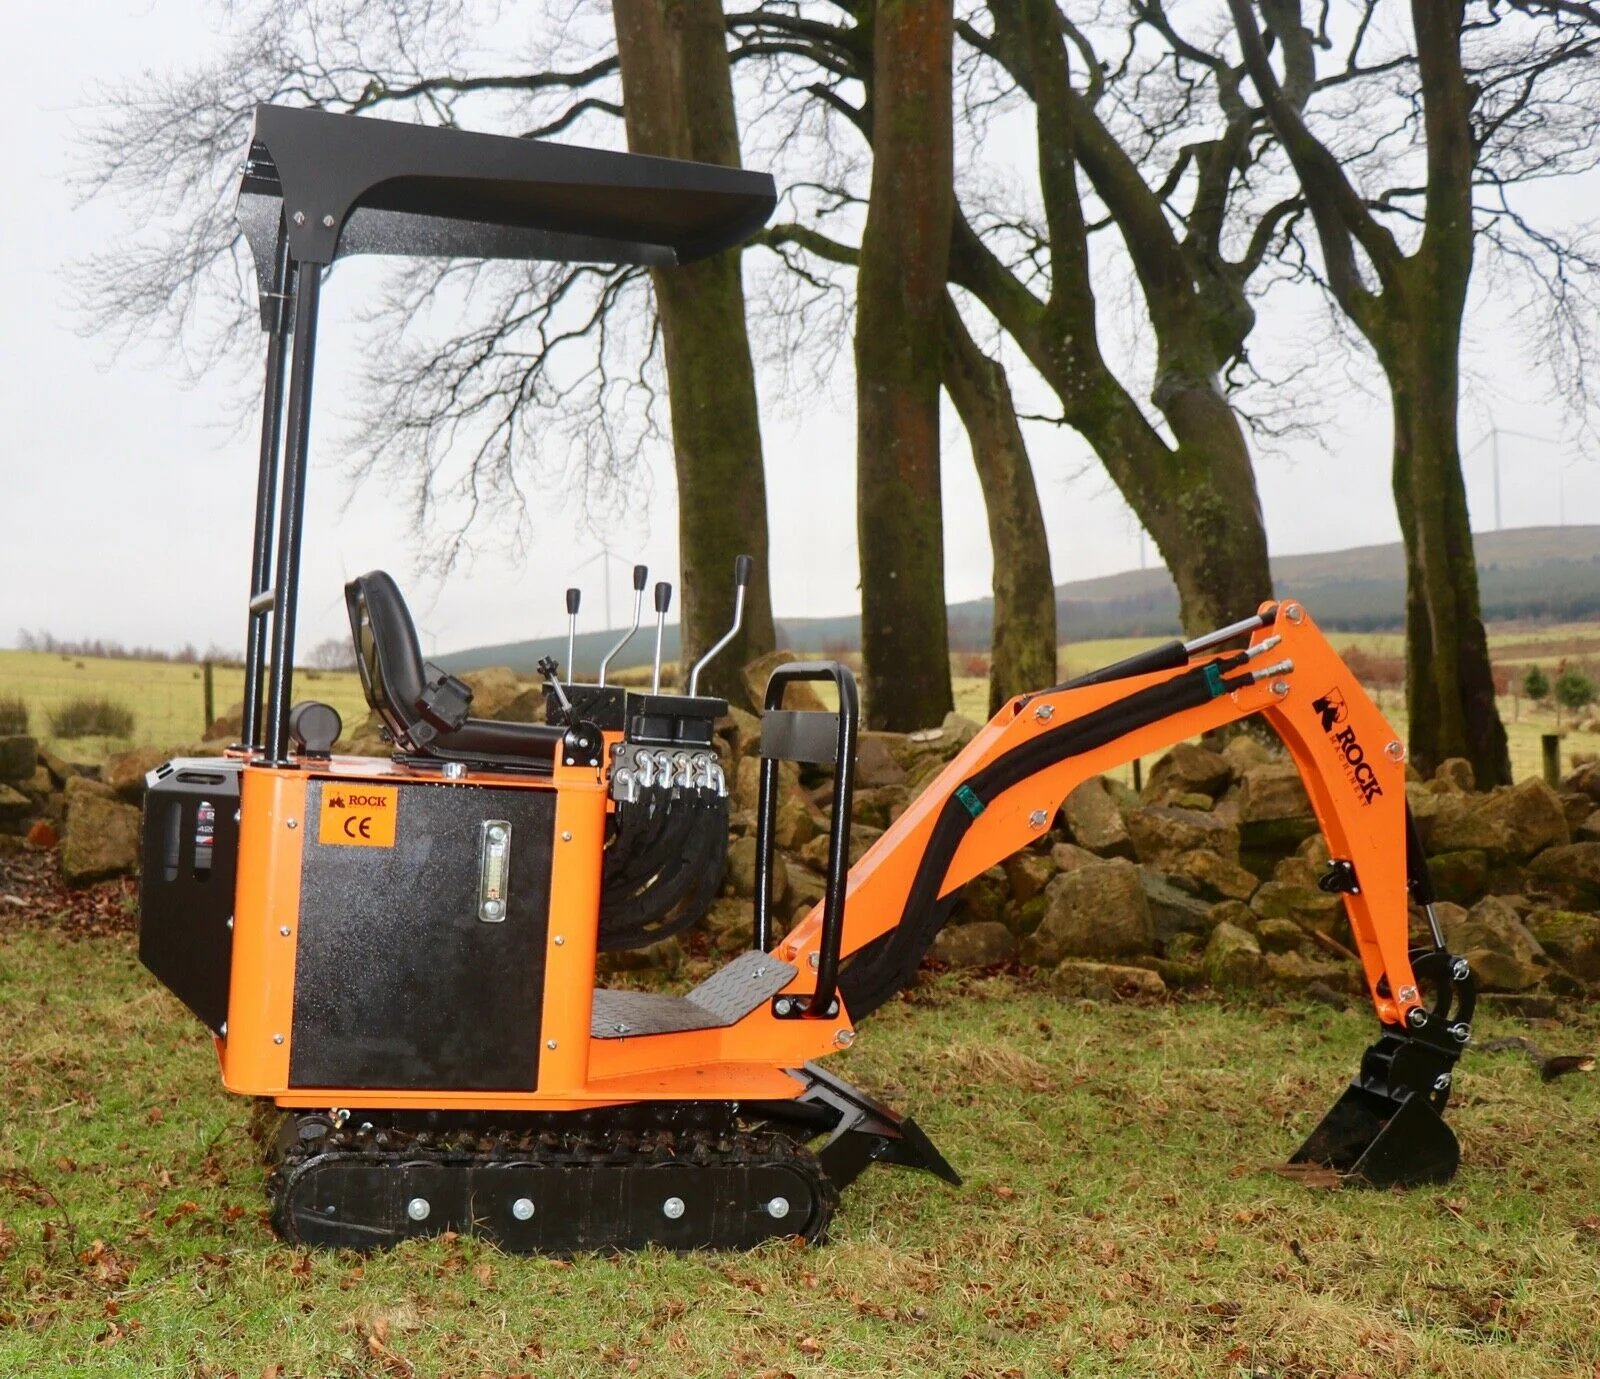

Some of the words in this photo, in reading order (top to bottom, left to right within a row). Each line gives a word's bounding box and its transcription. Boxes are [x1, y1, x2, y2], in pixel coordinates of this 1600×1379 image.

[1329, 735, 1368, 808] MACHINERY
[1335, 725, 1383, 805] ROCK
[348, 795, 387, 807] ROCK
[344, 816, 372, 839] CE
